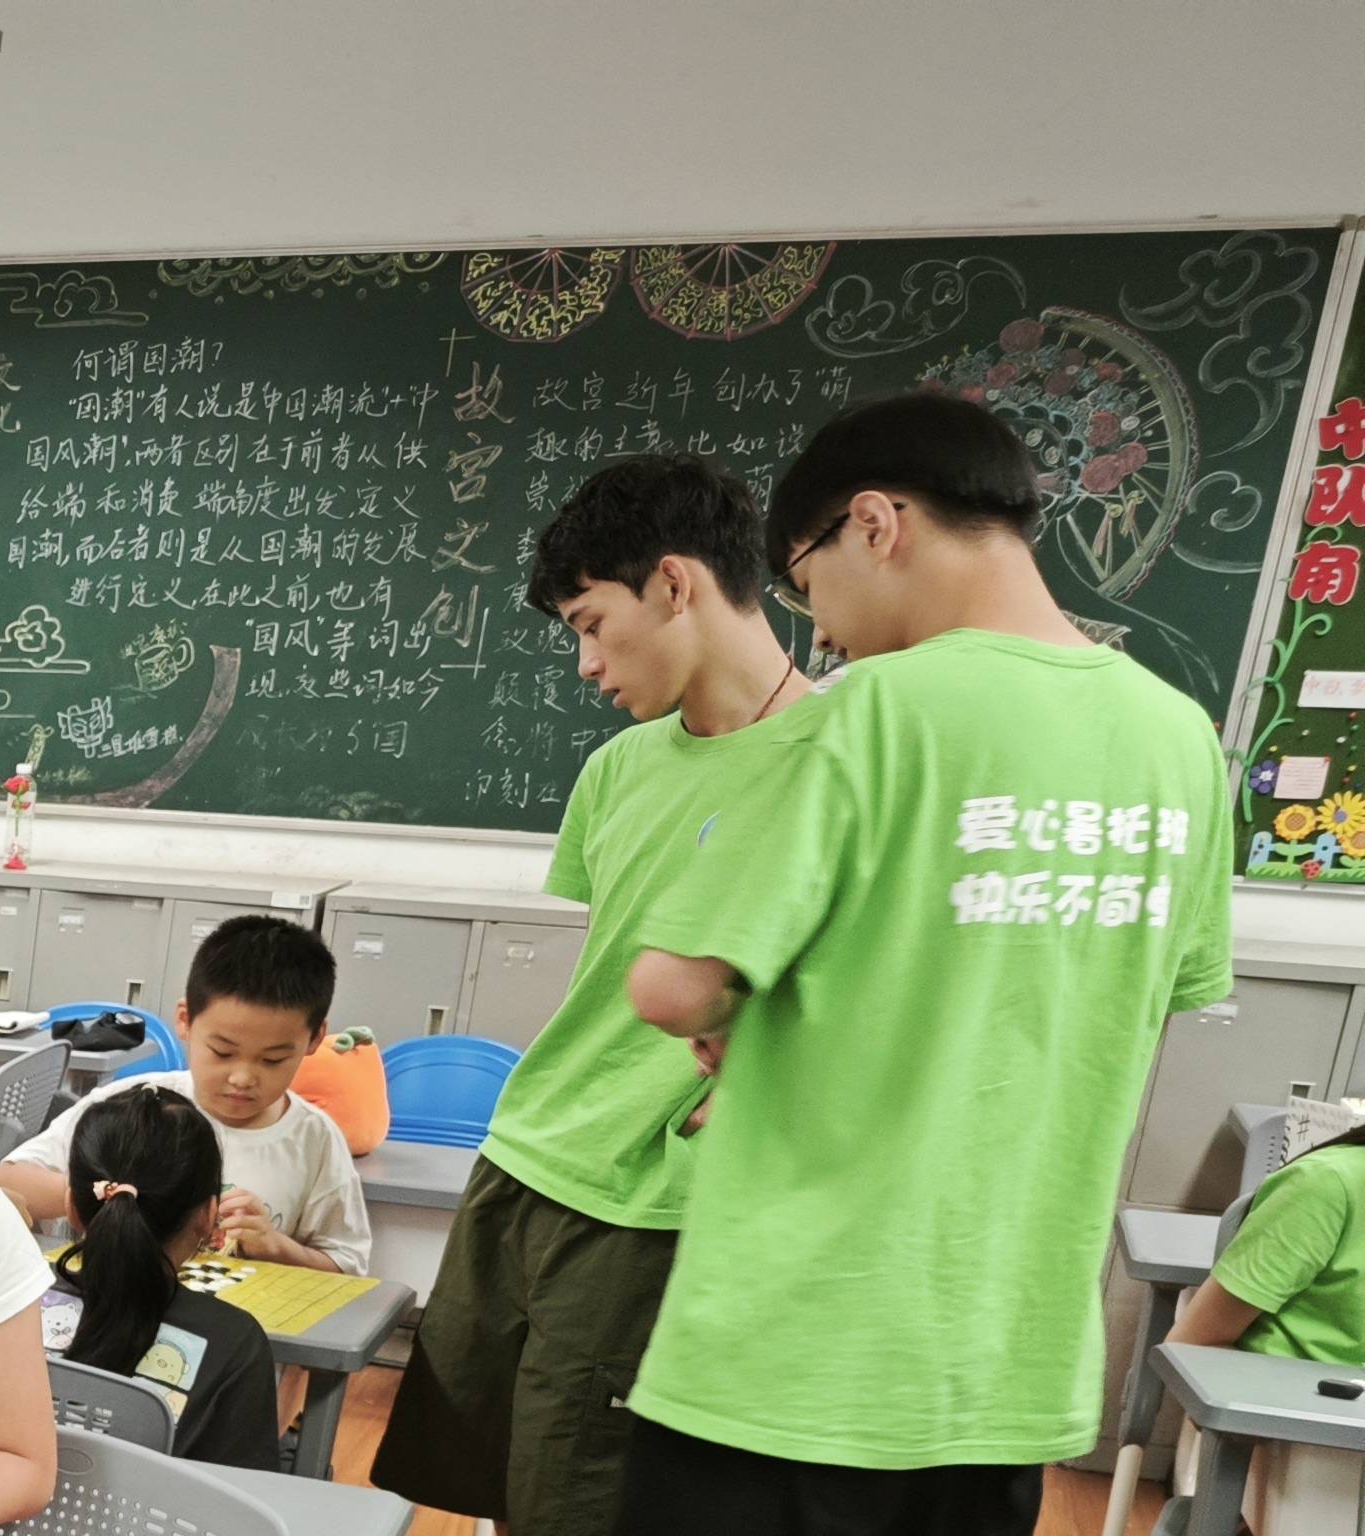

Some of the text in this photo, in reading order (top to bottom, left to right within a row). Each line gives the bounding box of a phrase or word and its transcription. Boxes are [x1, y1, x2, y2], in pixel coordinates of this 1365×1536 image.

[72, 337, 223, 384] 何谓国潮？
[421, 361, 517, 648] 故宫文创
[1288, 397, 1365, 606] 中队角
[494, 619, 575, 655] 玫瑰
[955, 795, 1189, 856] 爱心暑托班
